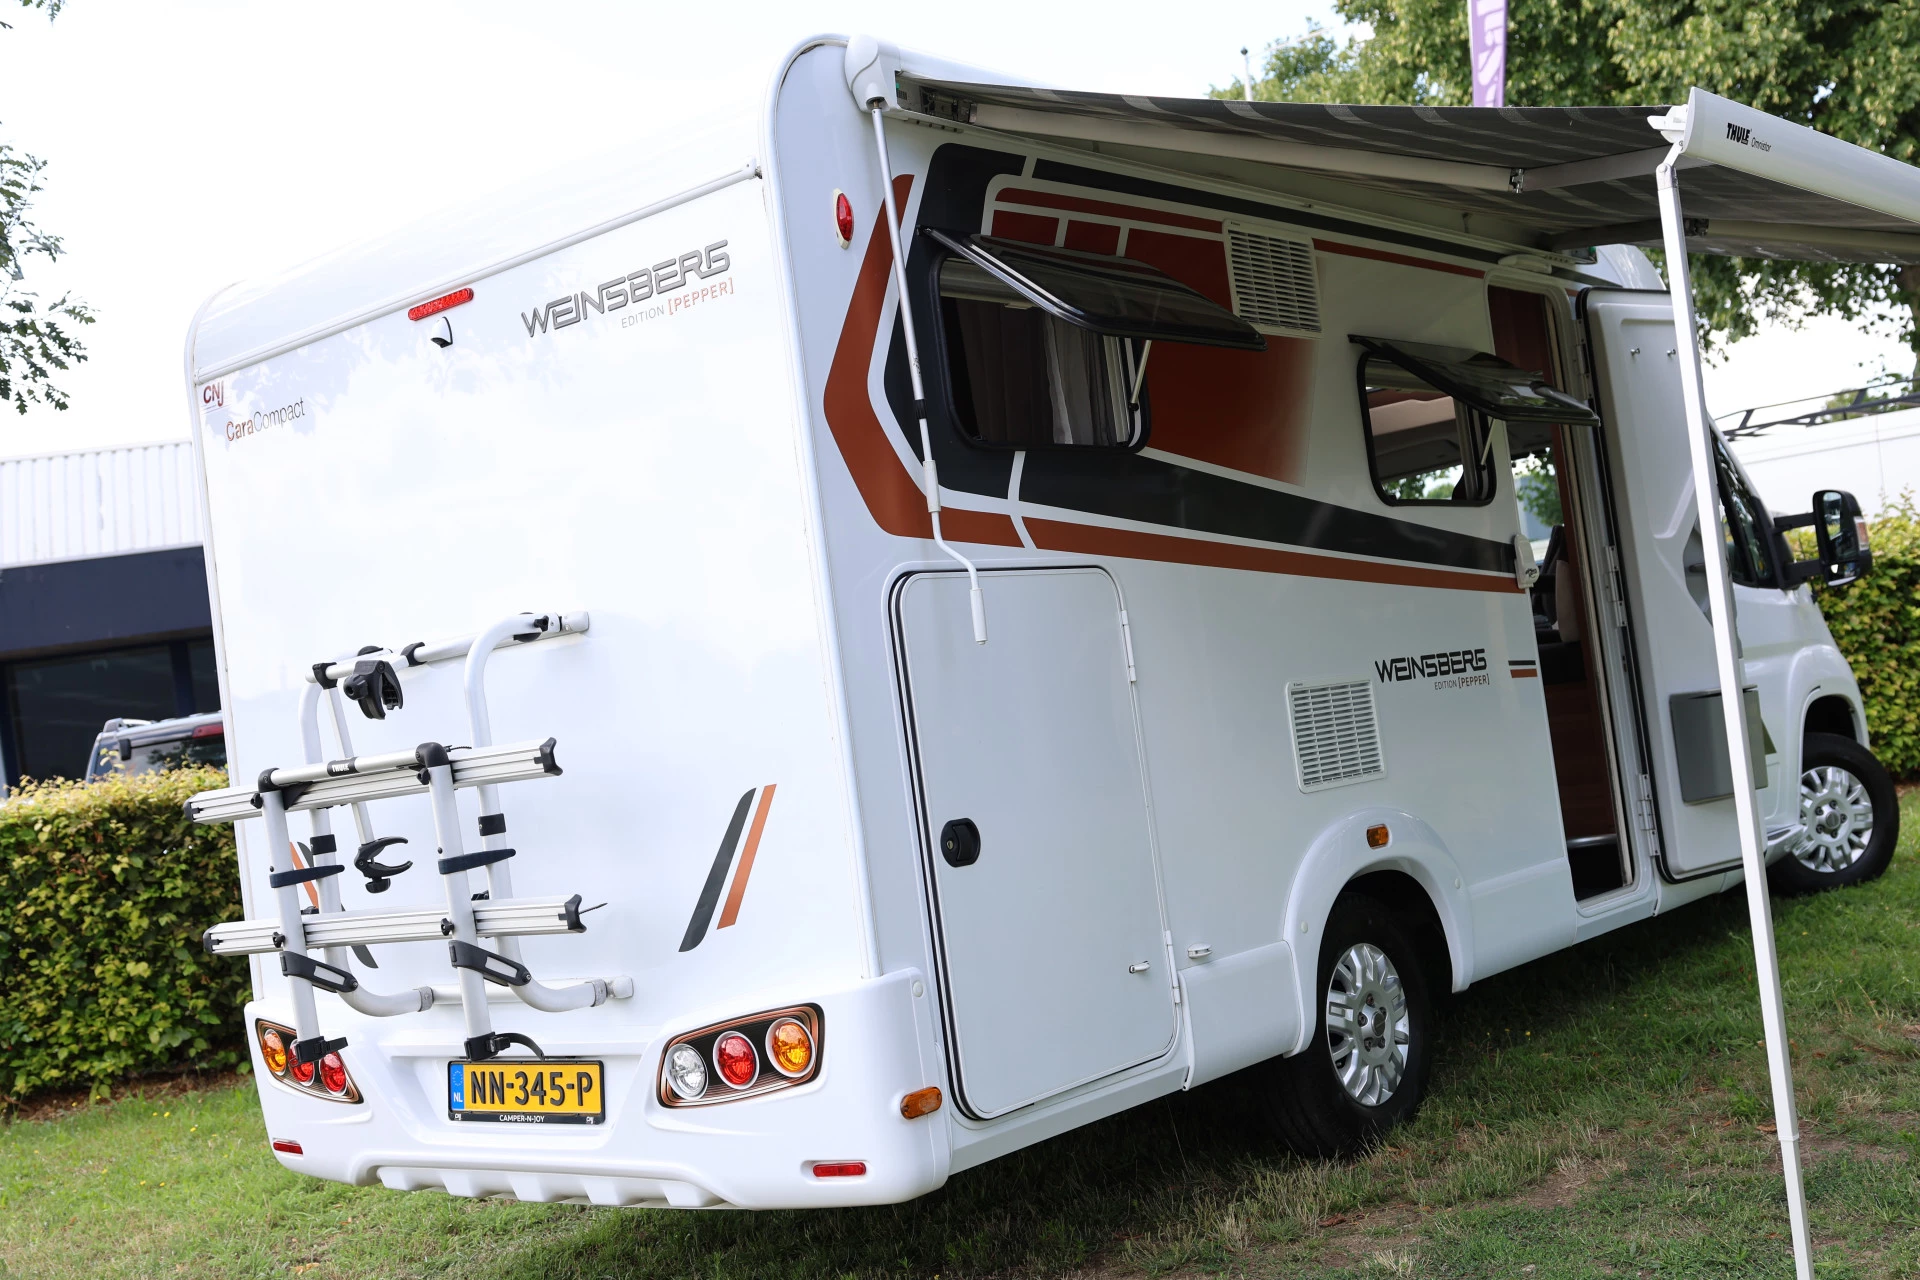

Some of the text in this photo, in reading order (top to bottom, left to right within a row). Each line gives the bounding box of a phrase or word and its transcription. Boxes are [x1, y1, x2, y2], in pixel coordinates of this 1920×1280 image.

[1726, 122, 1750, 145] THULE
[521, 239, 731, 338] WEINSBERG
[621, 304, 665, 329] EDITION
[203, 380, 225, 407] CNJ
[226, 397, 306, 441] CaraCompact
[1374, 648, 1488, 683] WEINSBERG
[1434, 680, 1458, 690] EDITION
[331, 763, 350, 773] THULE
[453, 1092, 463, 1103] NL
[470, 1070, 594, 1107] NN-345-P
[499, 1114, 545, 1124] CAMPER-N-JOY
